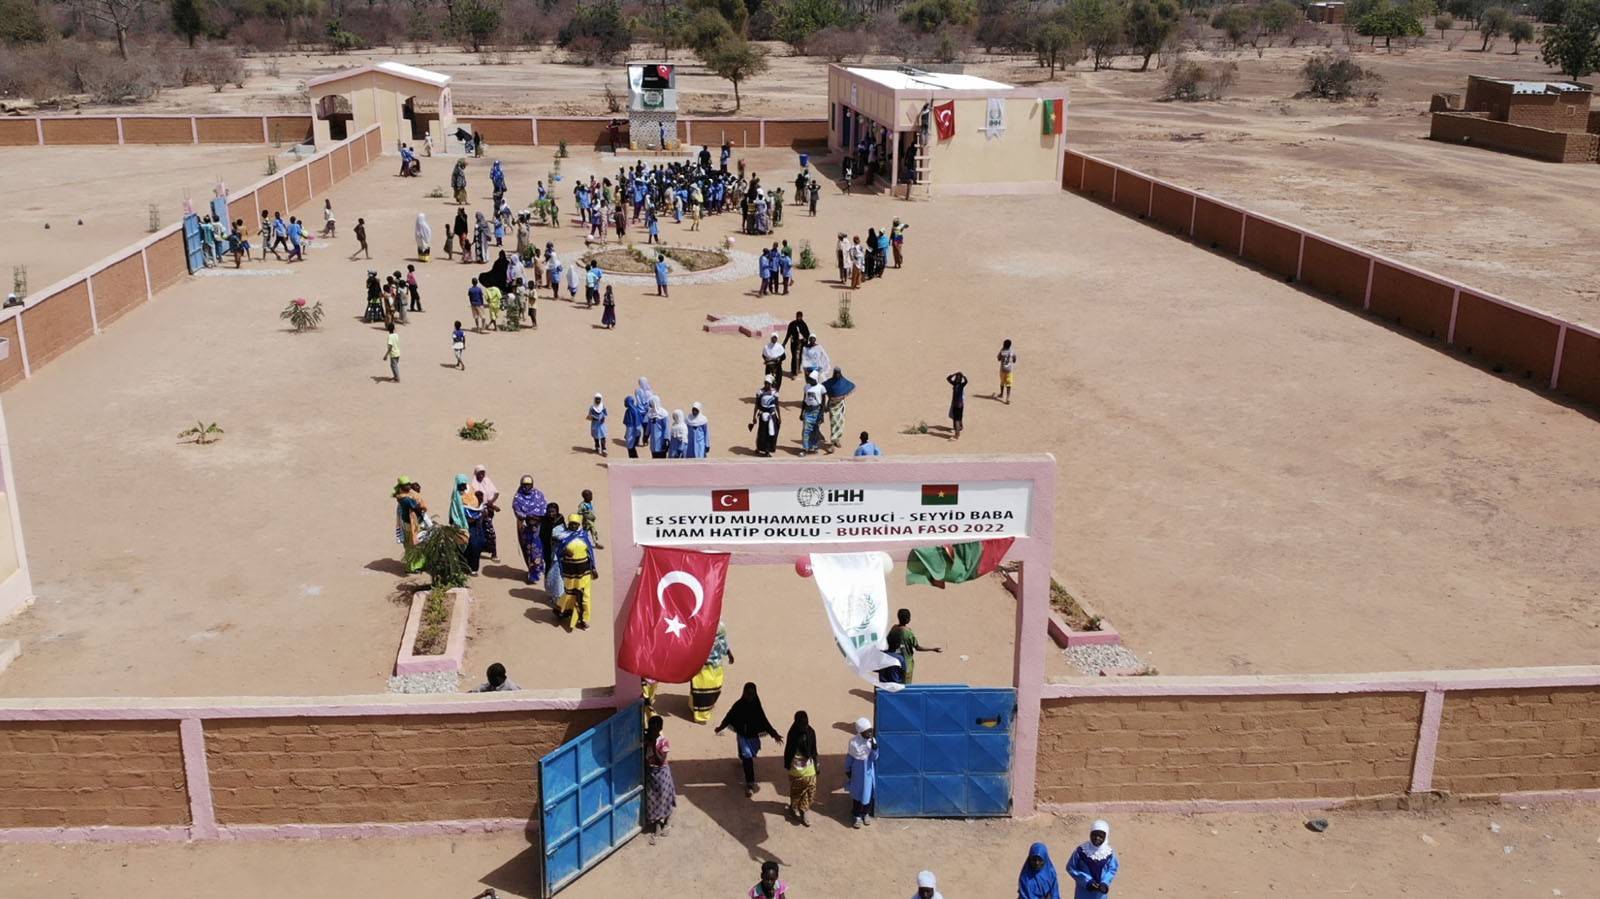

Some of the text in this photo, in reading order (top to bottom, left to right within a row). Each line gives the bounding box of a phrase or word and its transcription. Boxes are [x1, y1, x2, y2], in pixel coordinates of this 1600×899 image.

[646, 516, 664, 525] ES
[669, 513, 726, 525] SEYYİD
[730, 515, 831, 524] MUHAMMED
[836, 513, 895, 524] SURUCİ
[910, 509, 965, 522] SEYYİD
[970, 510, 1014, 520] BABA
[656, 526, 704, 538] İMAM
[710, 525, 760, 538] HATİP
[764, 527, 820, 537] OKULU
[837, 523, 913, 537] BURKİNA
[918, 524, 959, 534] FASO
[963, 523, 1005, 533] 2022
